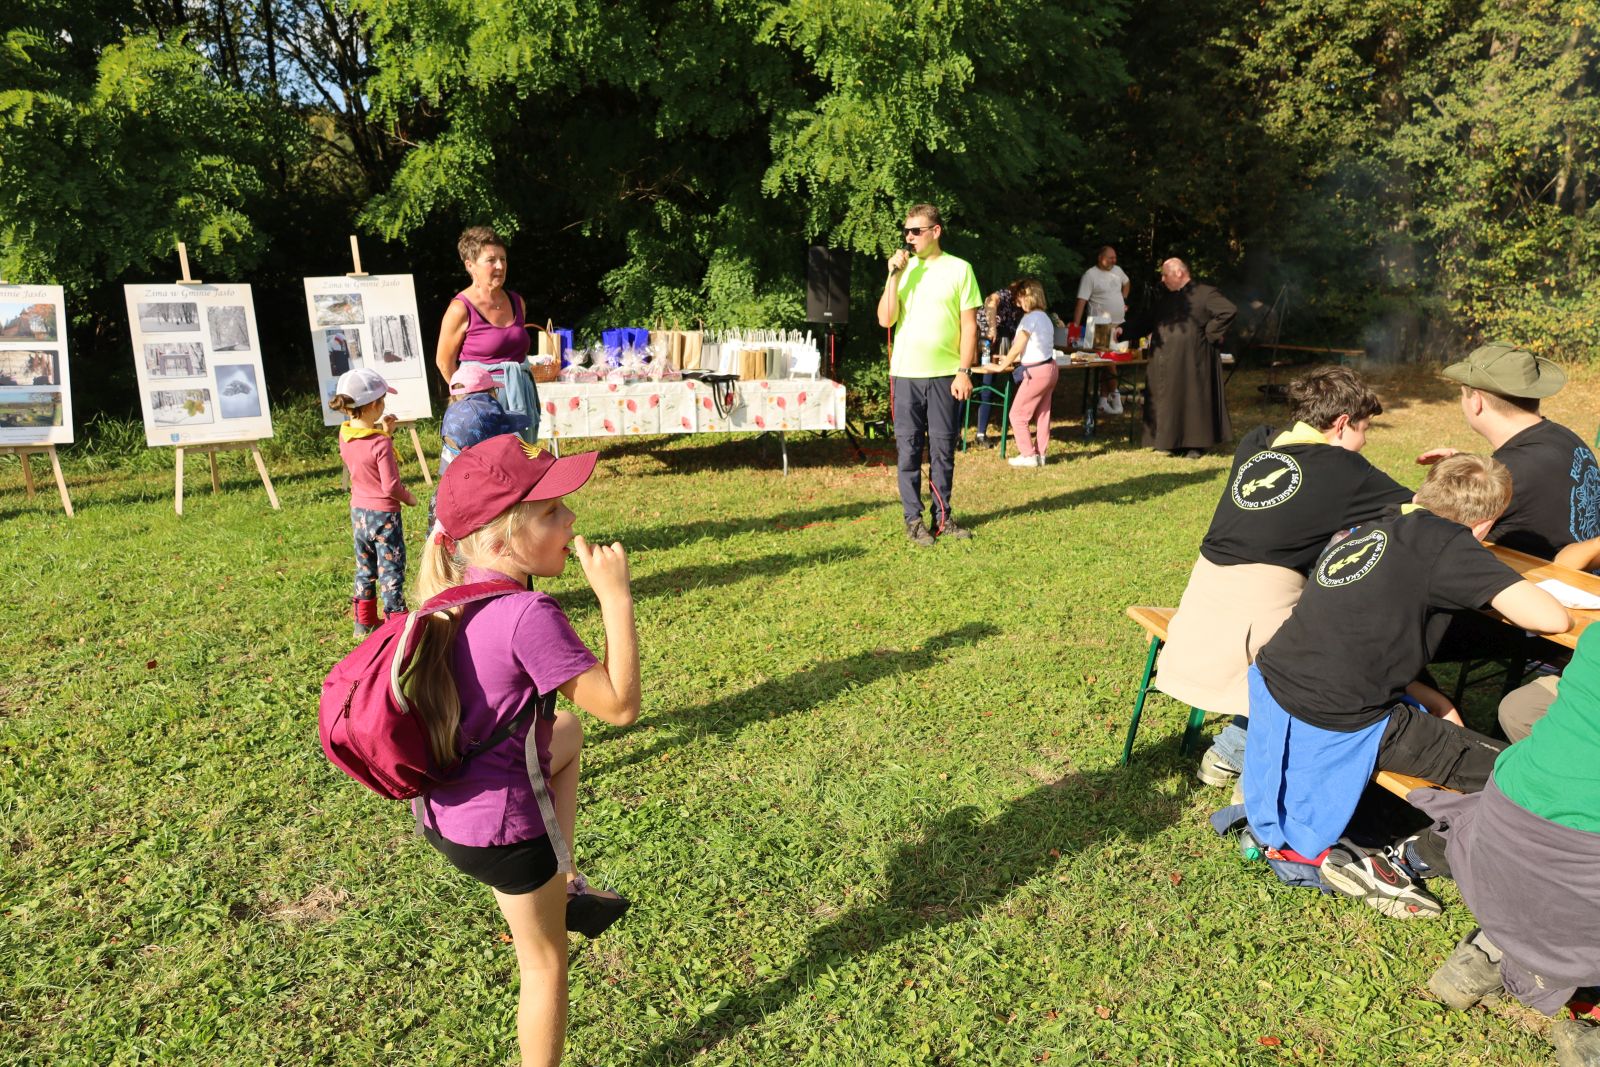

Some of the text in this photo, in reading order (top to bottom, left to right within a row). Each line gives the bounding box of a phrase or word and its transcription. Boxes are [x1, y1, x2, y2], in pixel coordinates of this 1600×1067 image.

[144, 288, 168, 298] Zima
[181, 288, 211, 300] Gminie
[213, 287, 236, 298] Jasło
[1260, 484, 1296, 507] JASIELSKA
[1345, 552, 1379, 581] JASIELSKA
